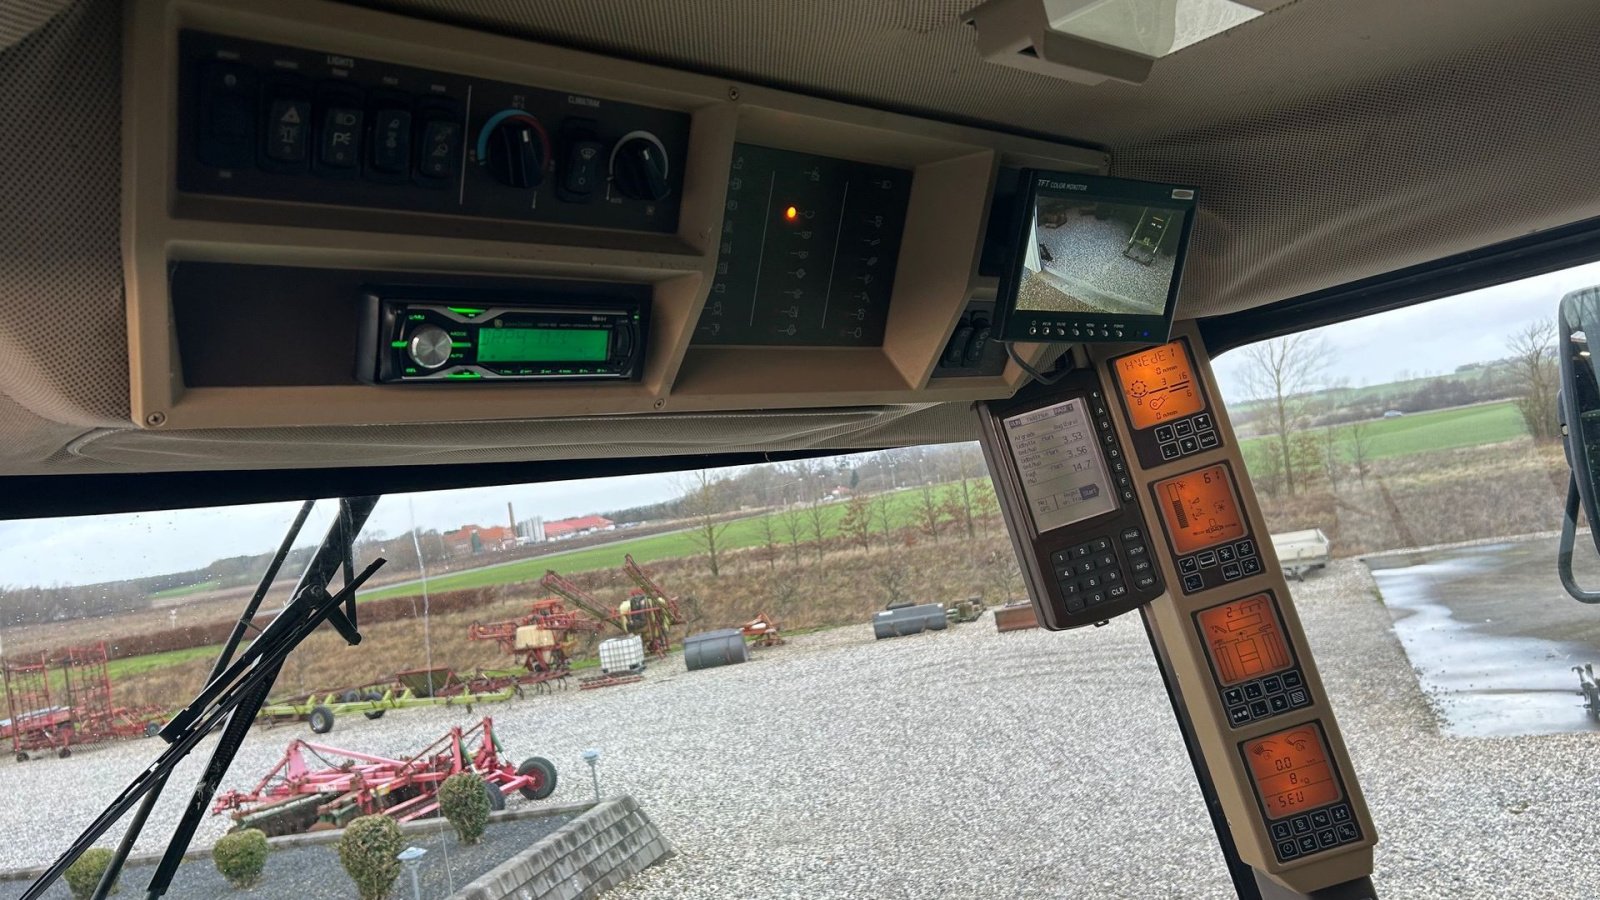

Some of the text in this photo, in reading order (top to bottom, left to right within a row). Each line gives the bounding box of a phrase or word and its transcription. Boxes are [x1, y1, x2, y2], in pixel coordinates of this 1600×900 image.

[1037, 179, 1088, 191] TFT COLOR MONITOR
[1072, 459, 1091, 472] 14.7
[1125, 531, 1139, 539] PAGE
[1130, 546, 1144, 555] SETUP
[1136, 562, 1148, 570] INFO
[1141, 577, 1153, 585] RUN
[1111, 586, 1125, 596] CLR
[1274, 756, 1292, 772] 0.0
[1288, 772, 1298, 785] 8
